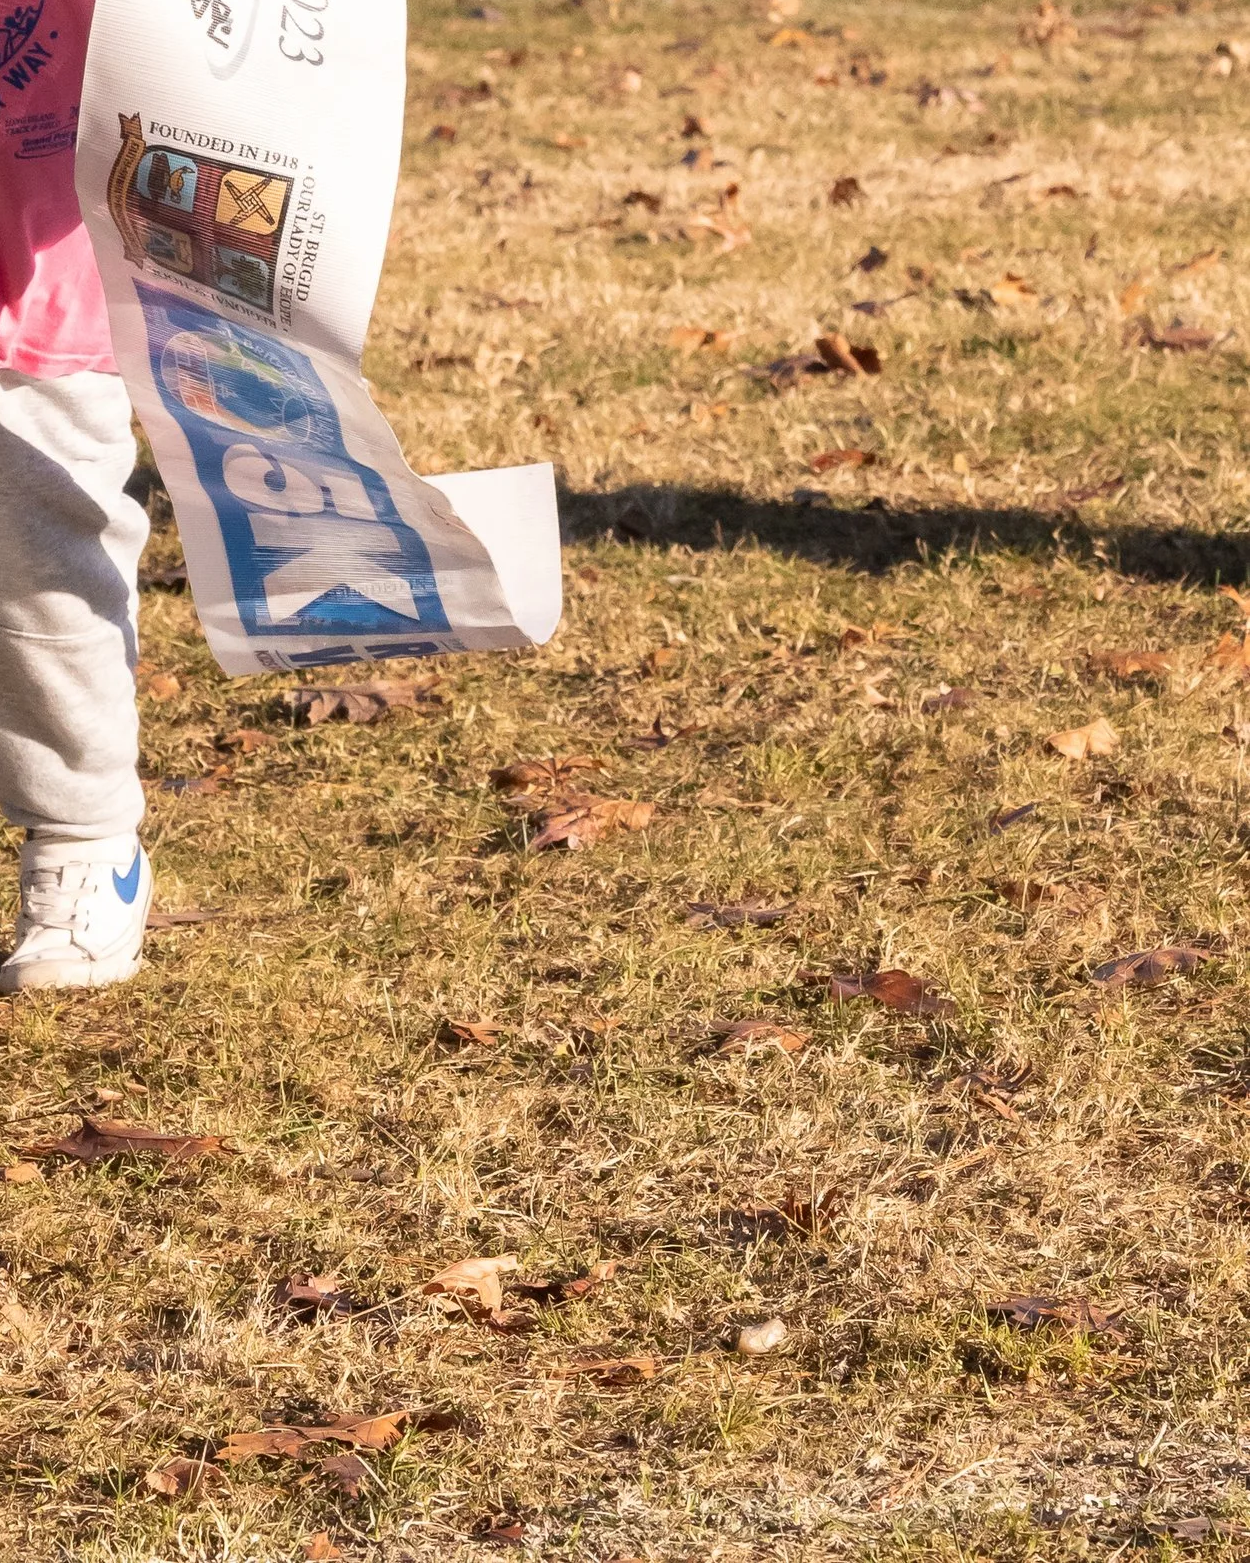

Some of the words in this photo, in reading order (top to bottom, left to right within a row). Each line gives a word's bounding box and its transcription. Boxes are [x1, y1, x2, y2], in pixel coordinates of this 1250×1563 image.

[2, 41, 54, 92] WAY
[149, 121, 235, 155] FOUNDED
[237, 142, 260, 161] IN
[264, 149, 300, 171] 1918
[296, 175, 318, 214] OUR
[286, 214, 308, 261] LADY
[309, 211, 327, 235] ST.
[281, 260, 298, 285] OF
[296, 236, 321, 303] BRIGID
[276, 285, 293, 327] HOPE
[222, 442, 422, 626] 5K
